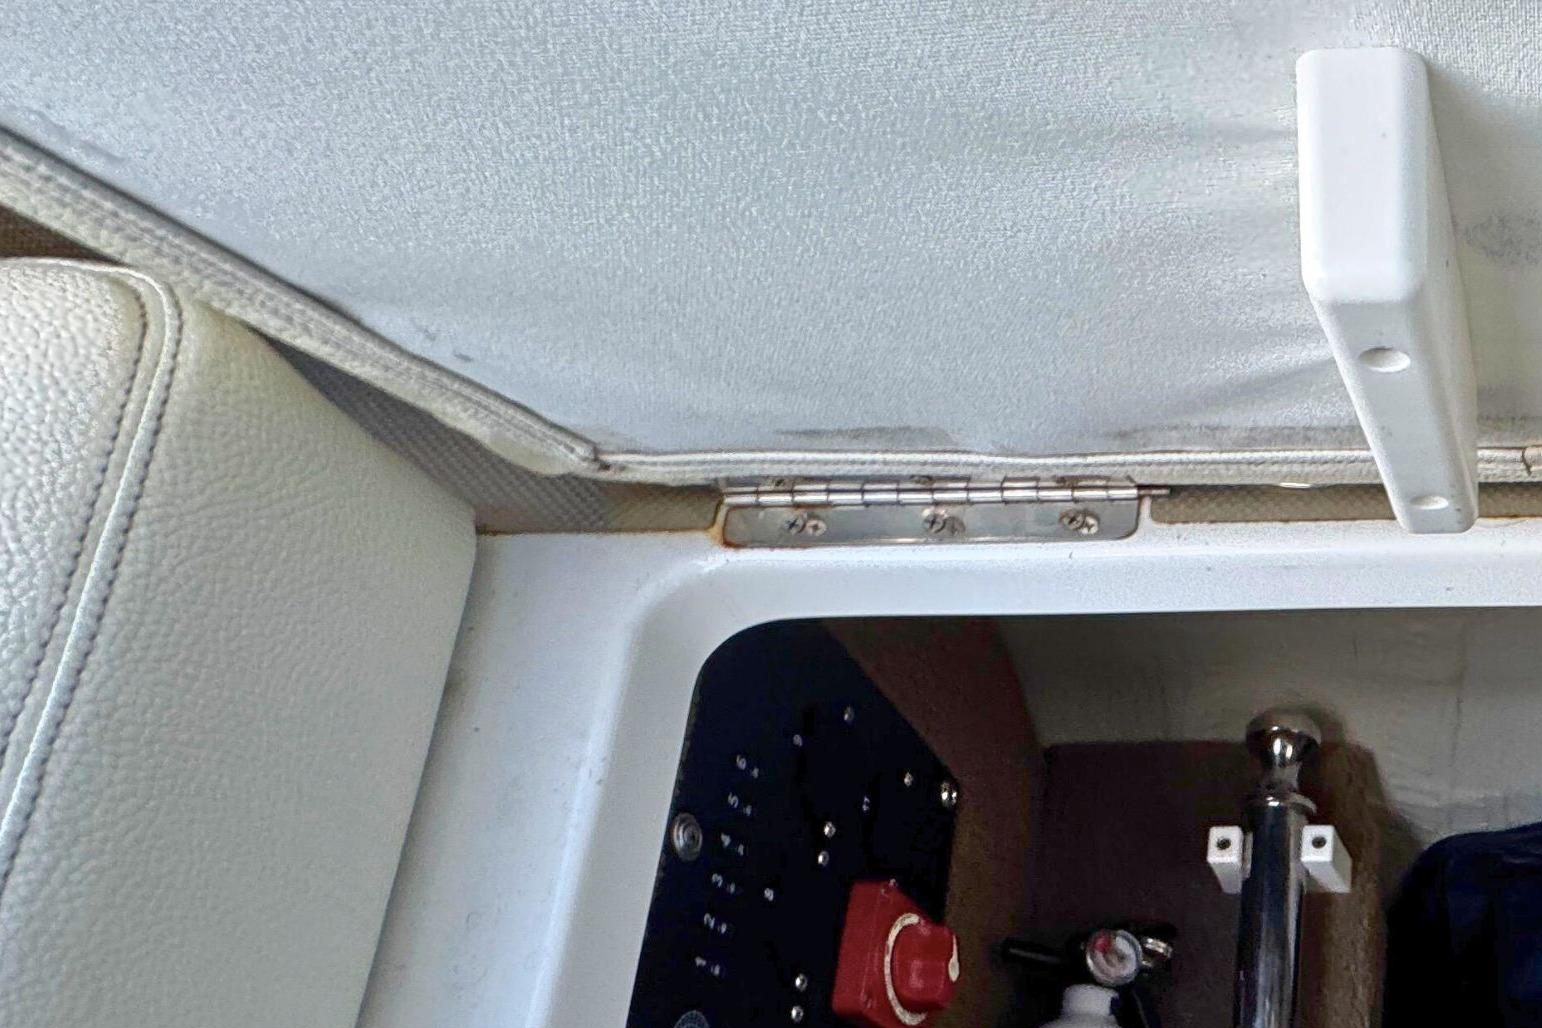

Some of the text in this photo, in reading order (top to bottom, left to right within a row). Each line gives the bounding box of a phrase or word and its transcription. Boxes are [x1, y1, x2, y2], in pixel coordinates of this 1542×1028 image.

[736, 754, 746, 770] 6
[727, 792, 738, 808] 5
[711, 873, 723, 888] 3
[703, 913, 715, 931] 2
[695, 956, 706, 967] 1
